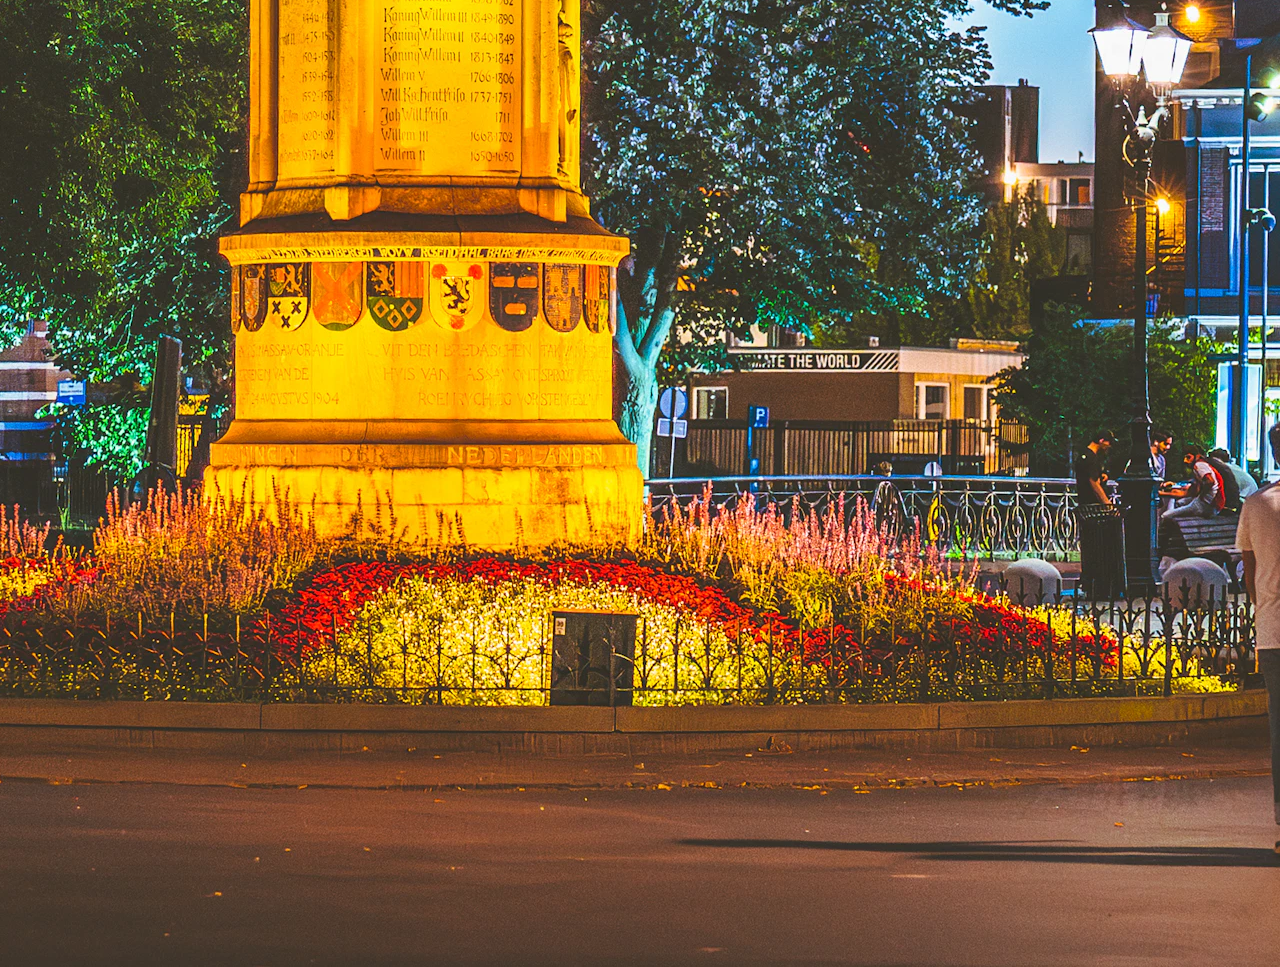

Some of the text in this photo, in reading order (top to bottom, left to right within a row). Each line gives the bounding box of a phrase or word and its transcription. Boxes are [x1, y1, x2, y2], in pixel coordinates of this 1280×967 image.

[380, 67, 416, 82] Willem
[470, 71, 515, 84] 1766-1806
[470, 91, 513, 104] 1737-1751
[380, 127, 416, 141] Willem
[380, 147, 416, 161] Willem
[788, 354, 813, 369] THE
[815, 354, 861, 369] WORLD
[420, 367, 450, 381] VAN
[313, 392, 340, 405] 1904
[756, 408, 766, 421] P
